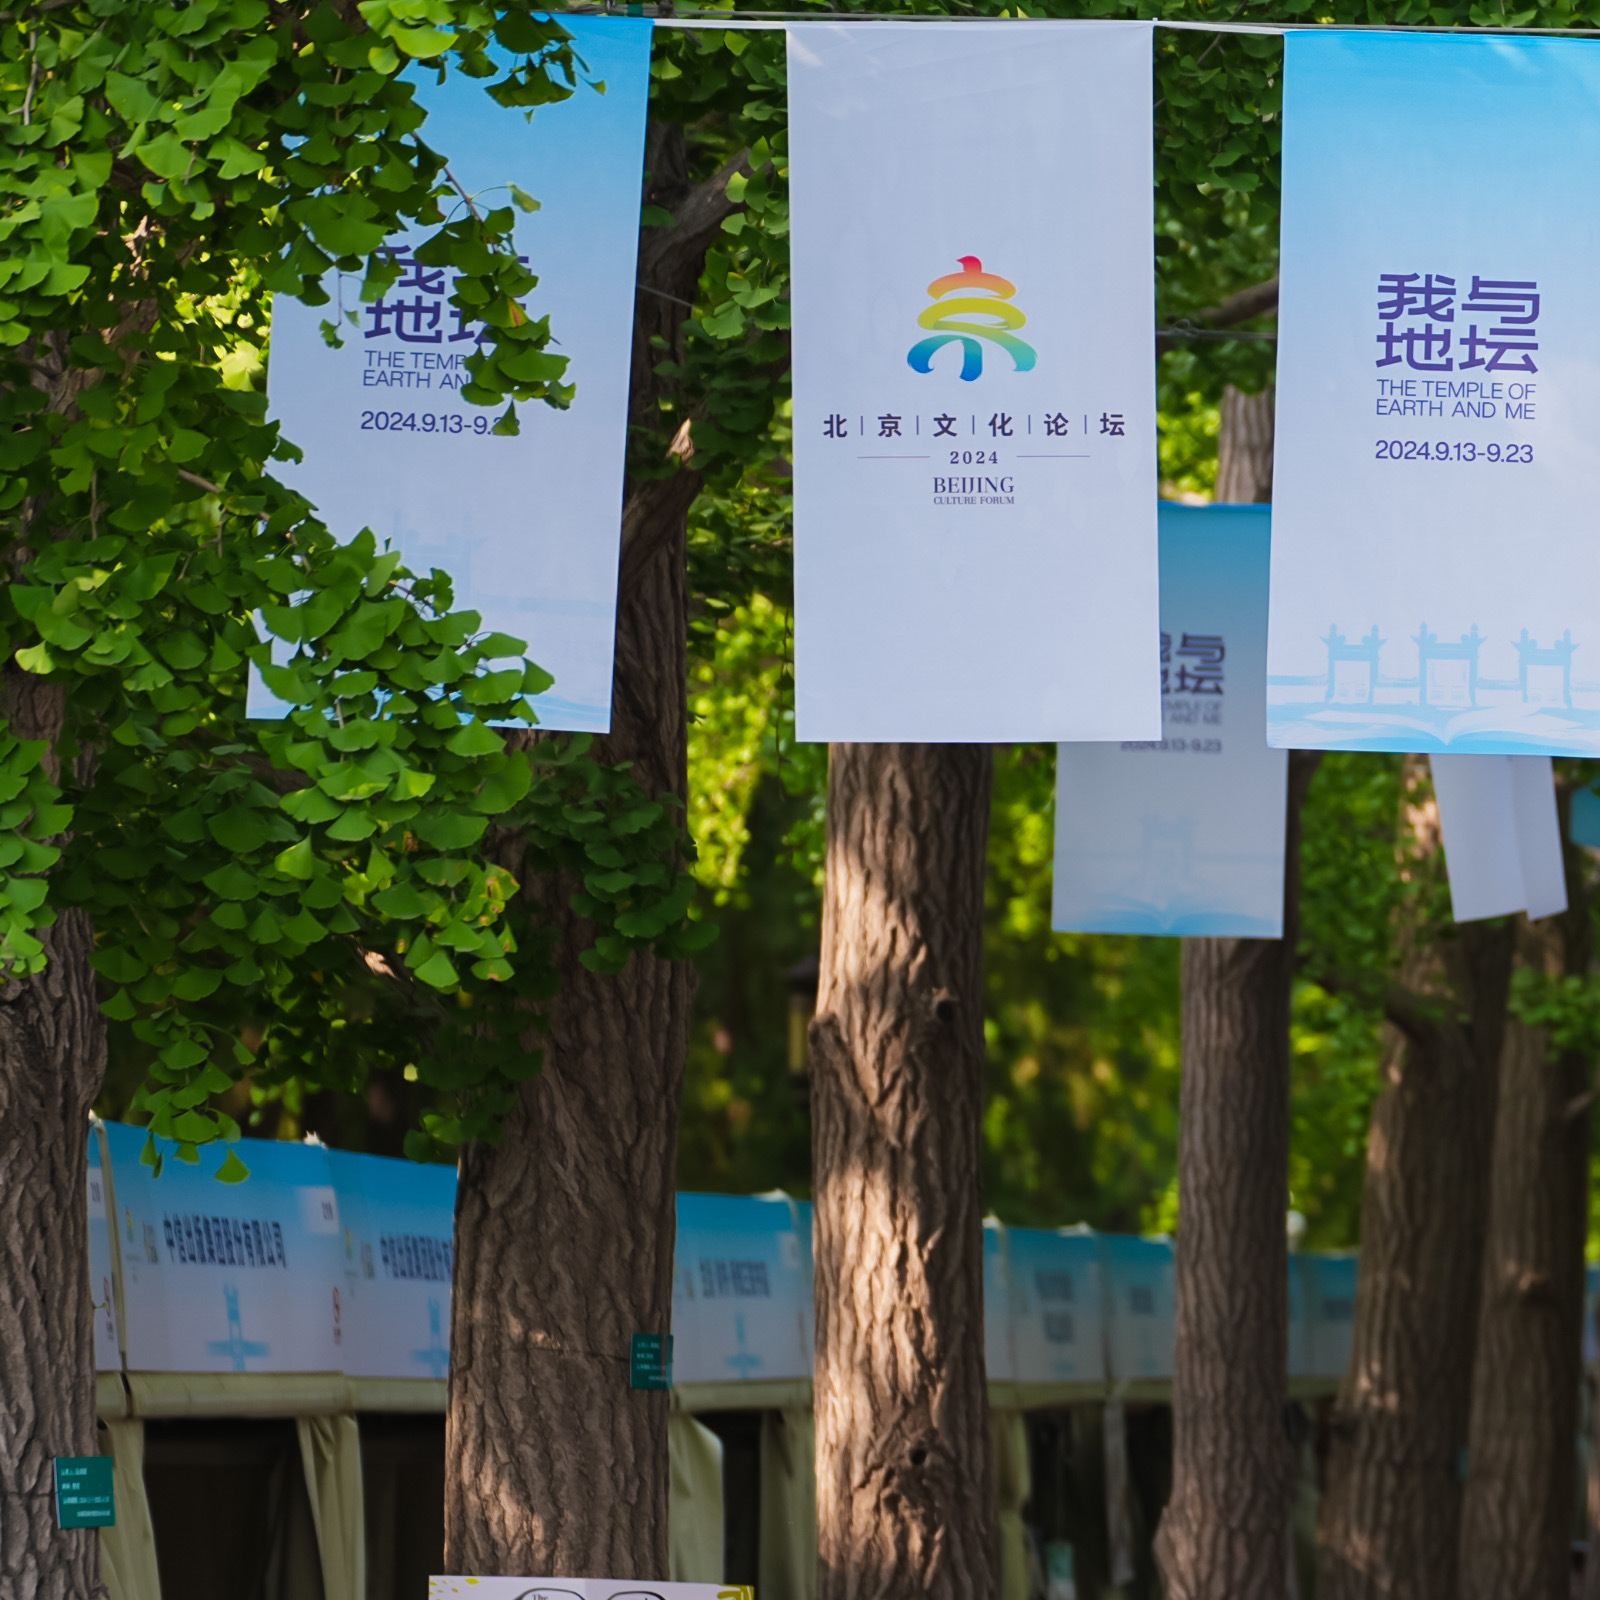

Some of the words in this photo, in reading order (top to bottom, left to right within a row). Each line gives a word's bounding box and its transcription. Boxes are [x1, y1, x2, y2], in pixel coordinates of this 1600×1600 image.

[1378, 273, 1540, 324] 我与
[1376, 322, 1539, 374] 地坛
[365, 351, 404, 368] THE
[410, 352, 480, 370] TEMP
[363, 370, 430, 388] EARTH
[439, 374, 470, 389] AN
[1377, 379, 1416, 397] THE
[1422, 381, 1503, 399] TEMPLE
[1508, 383, 1536, 400] OF
[1377, 399, 1443, 417] EARTH
[1452, 401, 1496, 418] AND
[1505, 403, 1536, 420] ME
[361, 411, 519, 434] 2024.9.13-9.
[950, 451, 998, 464] 2024
[1376, 440, 1533, 463] 2024.9.13-9.23
[933, 477, 1015, 494] BEIJING
[933, 497, 977, 505] CULTURE
[980, 497, 1015, 505] FORUM
[1160, 632, 1225, 664] 与
[1161, 664, 1224, 695] 坛
